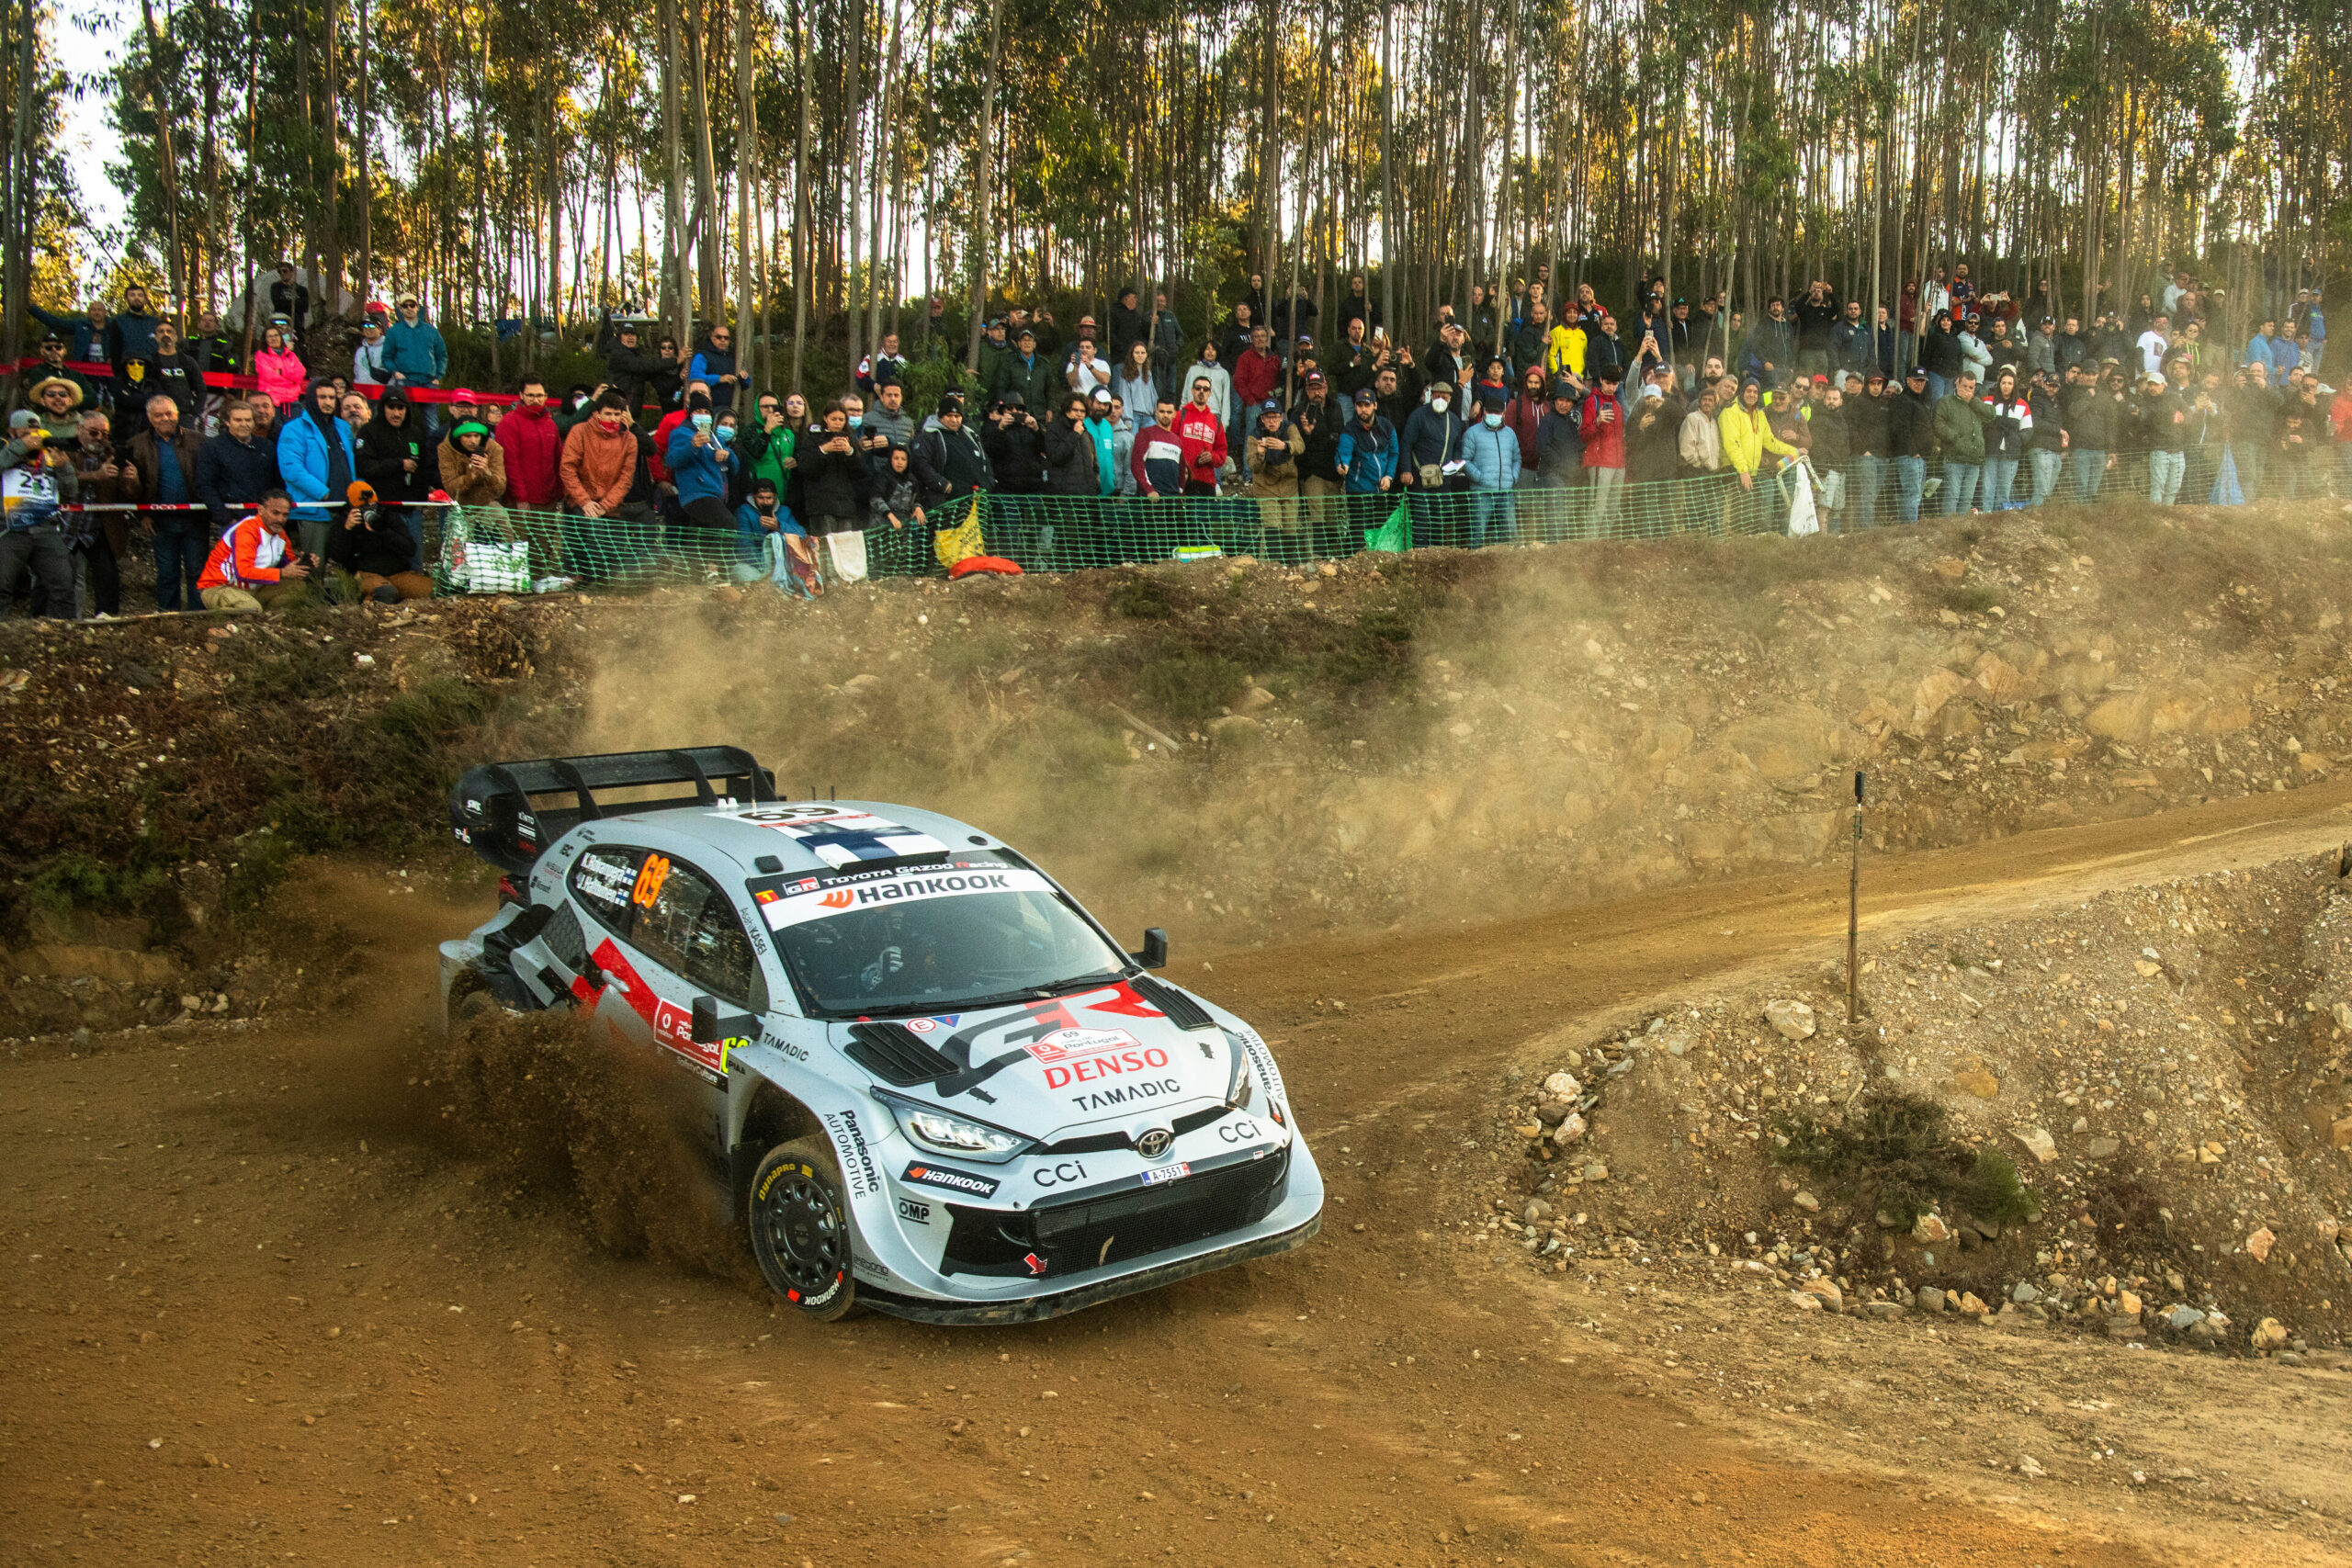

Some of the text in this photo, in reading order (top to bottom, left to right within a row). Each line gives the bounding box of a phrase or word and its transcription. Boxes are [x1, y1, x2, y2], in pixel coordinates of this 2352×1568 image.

[739, 807, 839, 821] 69
[633, 853, 670, 908] 69
[786, 881, 820, 896] GR
[822, 861, 1008, 886] TOYOTA GAZOO Racing
[763, 1032, 809, 1062] TAMADIC
[1042, 1048, 1169, 1089] DENSO
[1071, 1078, 1182, 1111] TAMADIC
[824, 1113, 866, 1200] AUTOMOTIVE
[840, 1110, 879, 1193] Panasonic
[899, 1201, 930, 1221] OMP
